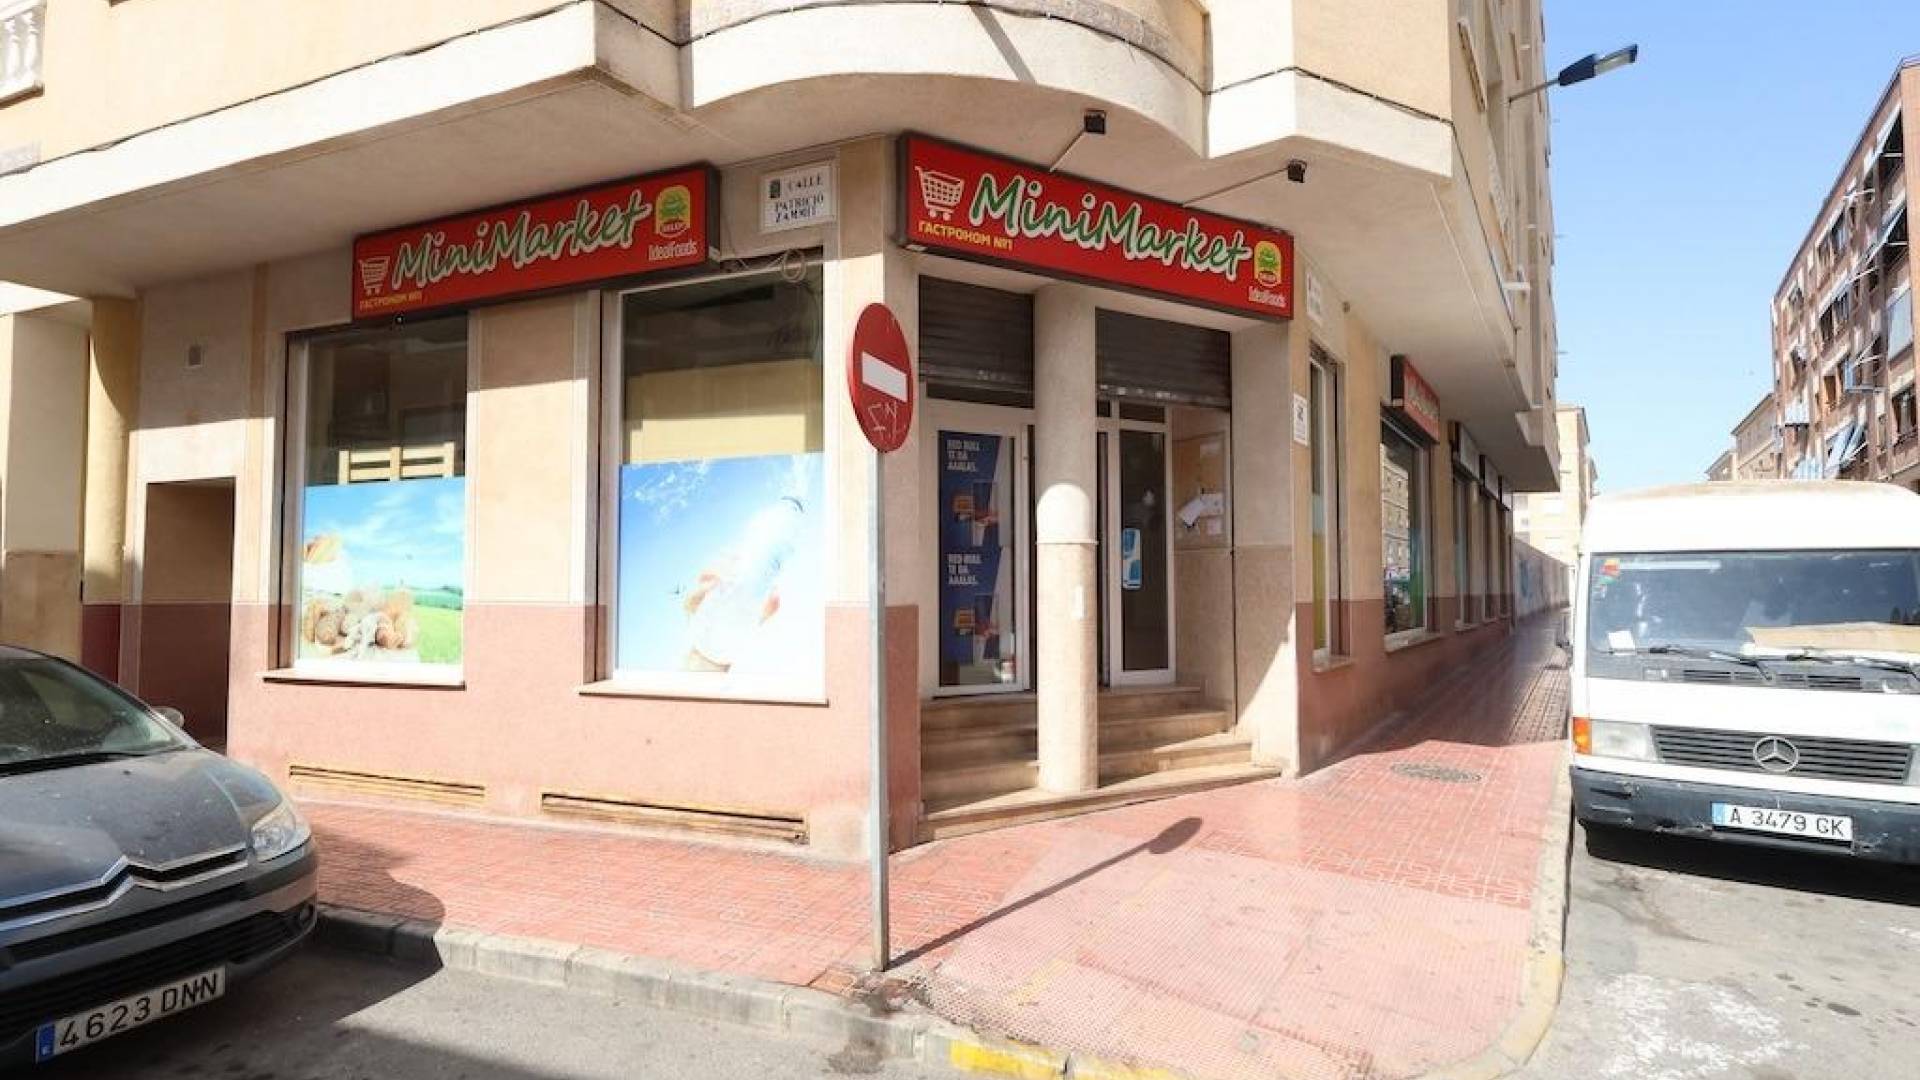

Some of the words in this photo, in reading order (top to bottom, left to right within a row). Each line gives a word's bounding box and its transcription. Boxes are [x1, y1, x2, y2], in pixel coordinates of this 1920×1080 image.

[787, 173, 823, 192] CALLE
[775, 191, 824, 212] PATRICIO
[391, 189, 653, 289] MiniMarket
[917, 219, 991, 249] ГАСТРОНОМ
[968, 173, 1253, 282] MiniMarket
[946, 439, 962, 450] RED
[963, 440, 980, 451] BULL
[947, 553, 963, 564] RED
[1730, 808, 1743, 824] A
[1752, 810, 1807, 832] 3479
[1816, 817, 1844, 837] GK
[59, 997, 151, 1047] 4623
[160, 973, 218, 1013] DNN
